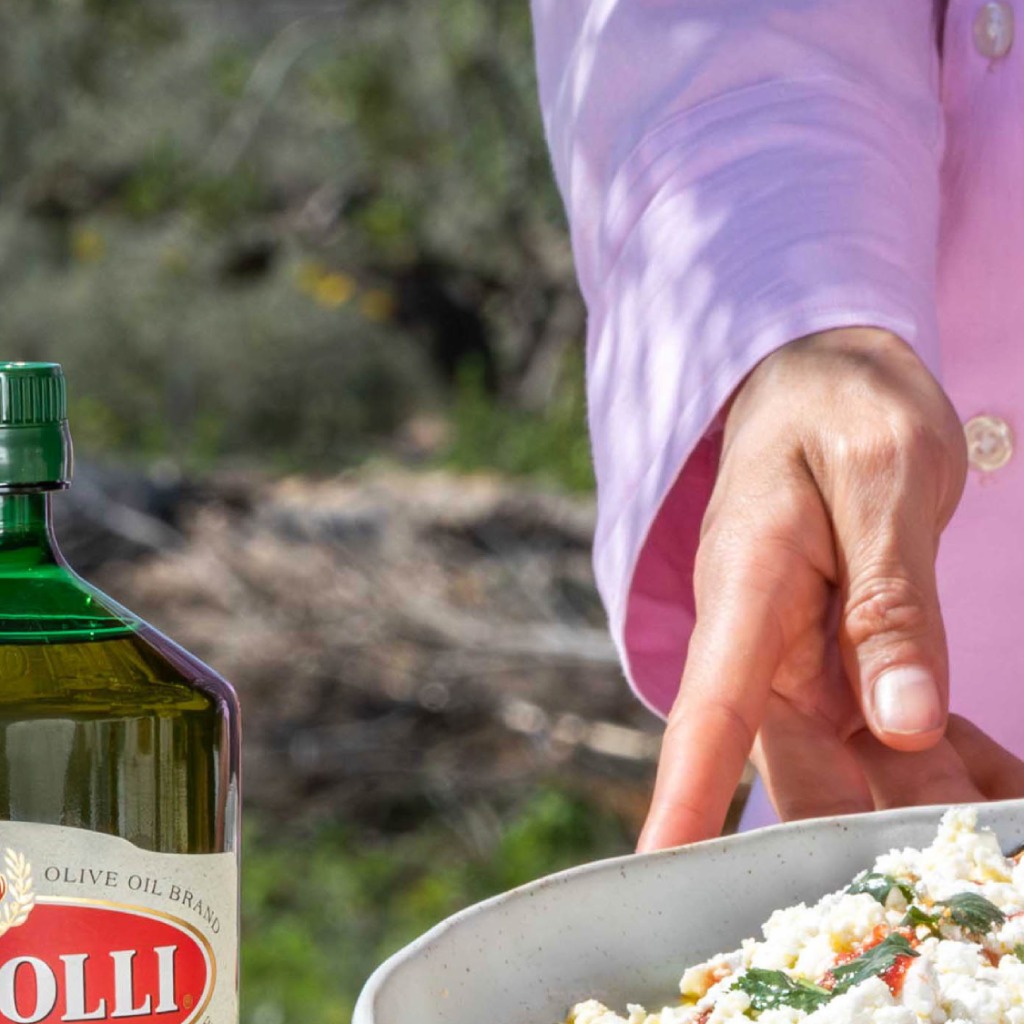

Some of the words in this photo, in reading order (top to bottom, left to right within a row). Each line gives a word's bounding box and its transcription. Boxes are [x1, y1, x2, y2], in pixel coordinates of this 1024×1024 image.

[44, 866, 118, 887] OLIVE
[128, 874, 162, 896] OIL
[169, 884, 221, 934] BRAND
